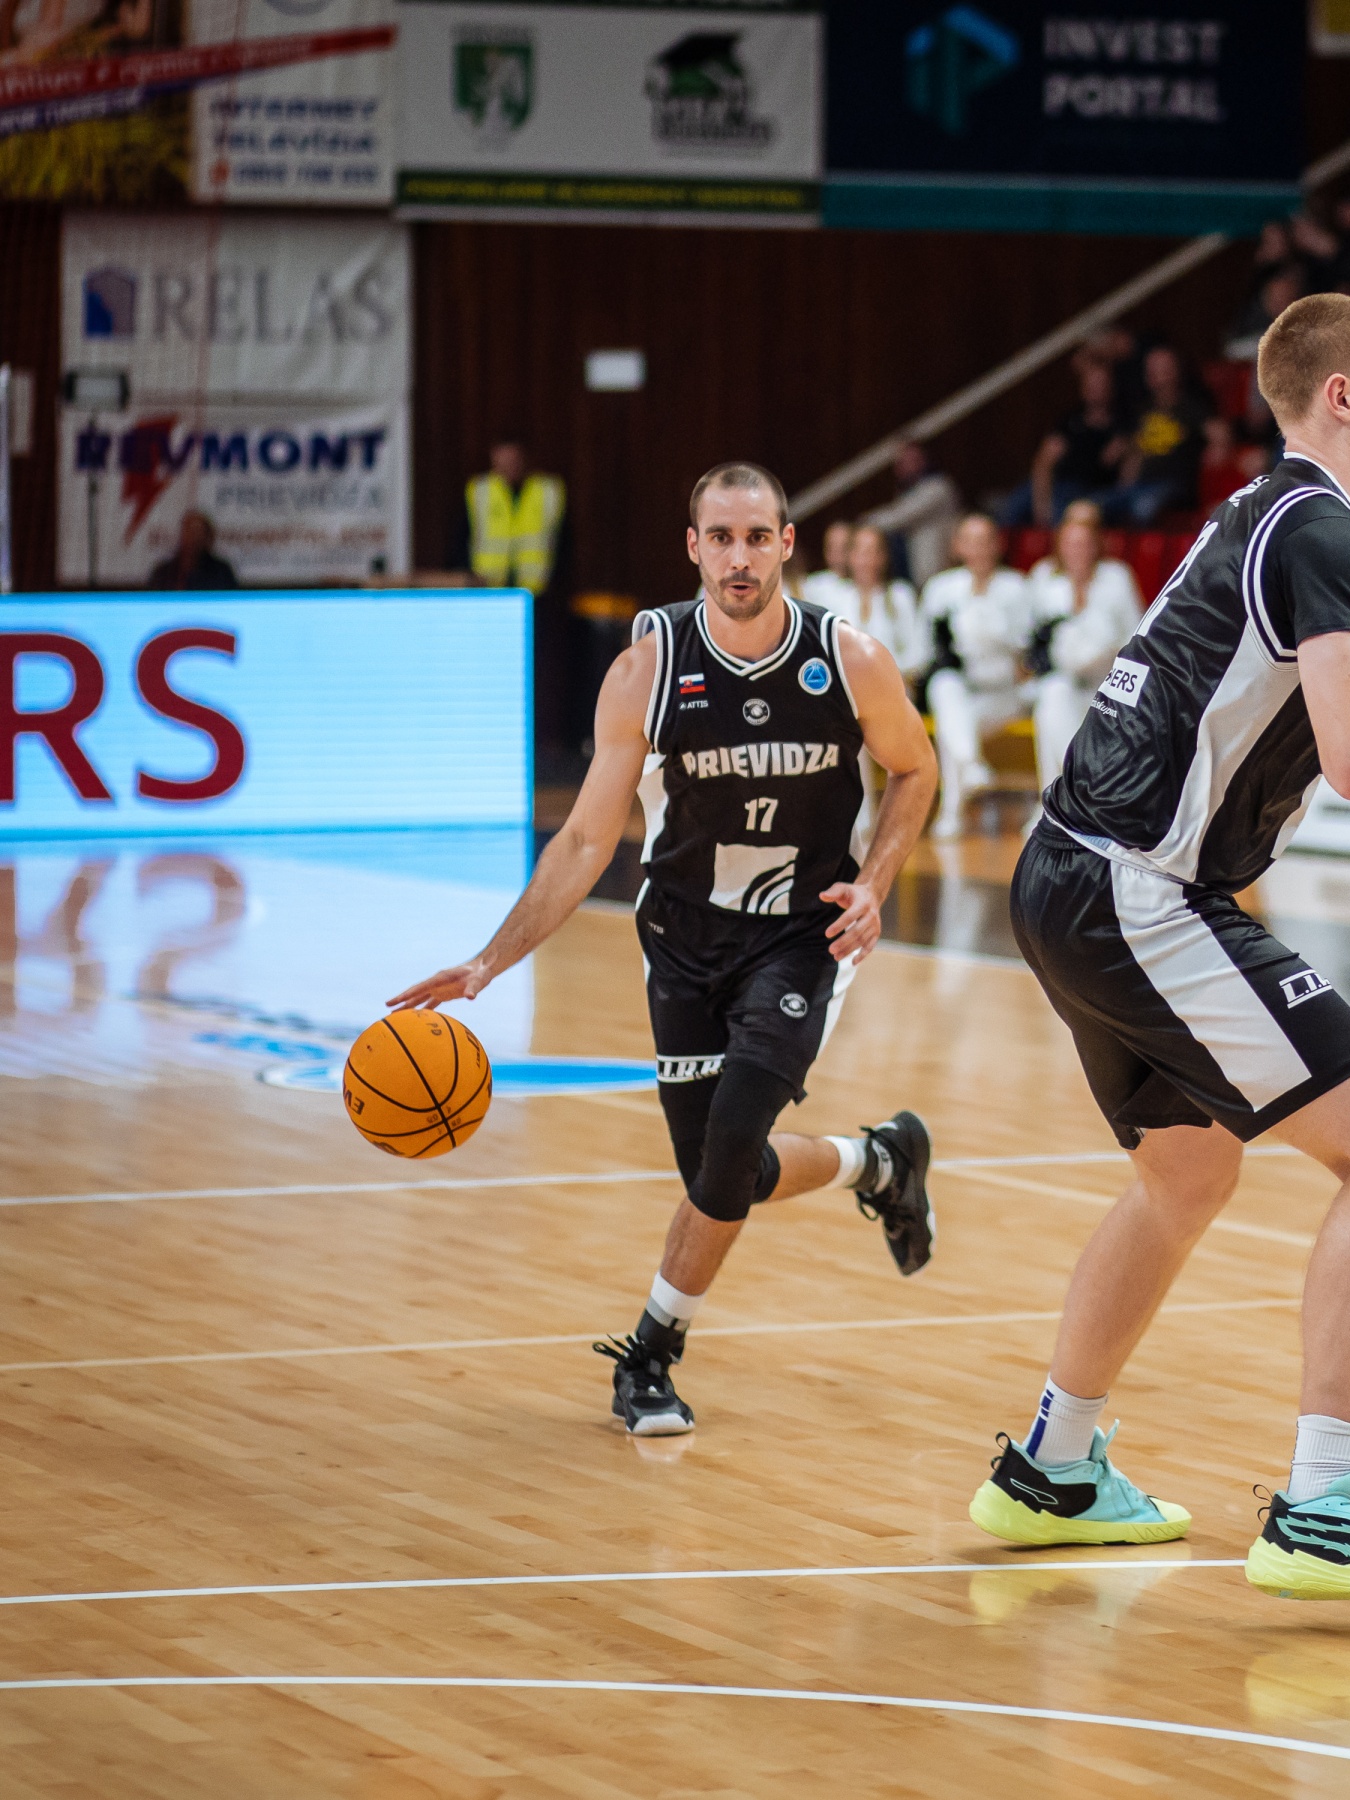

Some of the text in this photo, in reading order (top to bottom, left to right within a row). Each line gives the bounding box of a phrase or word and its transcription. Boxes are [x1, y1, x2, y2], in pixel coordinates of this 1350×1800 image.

[1043, 19, 1224, 60] INVEST
[1043, 75, 1224, 121] PORTAL
[152, 268, 393, 345] RELAS
[687, 700, 709, 709] ATTIS
[681, 741, 839, 780] PRIEVIDZA
[744, 797, 779, 833] 17
